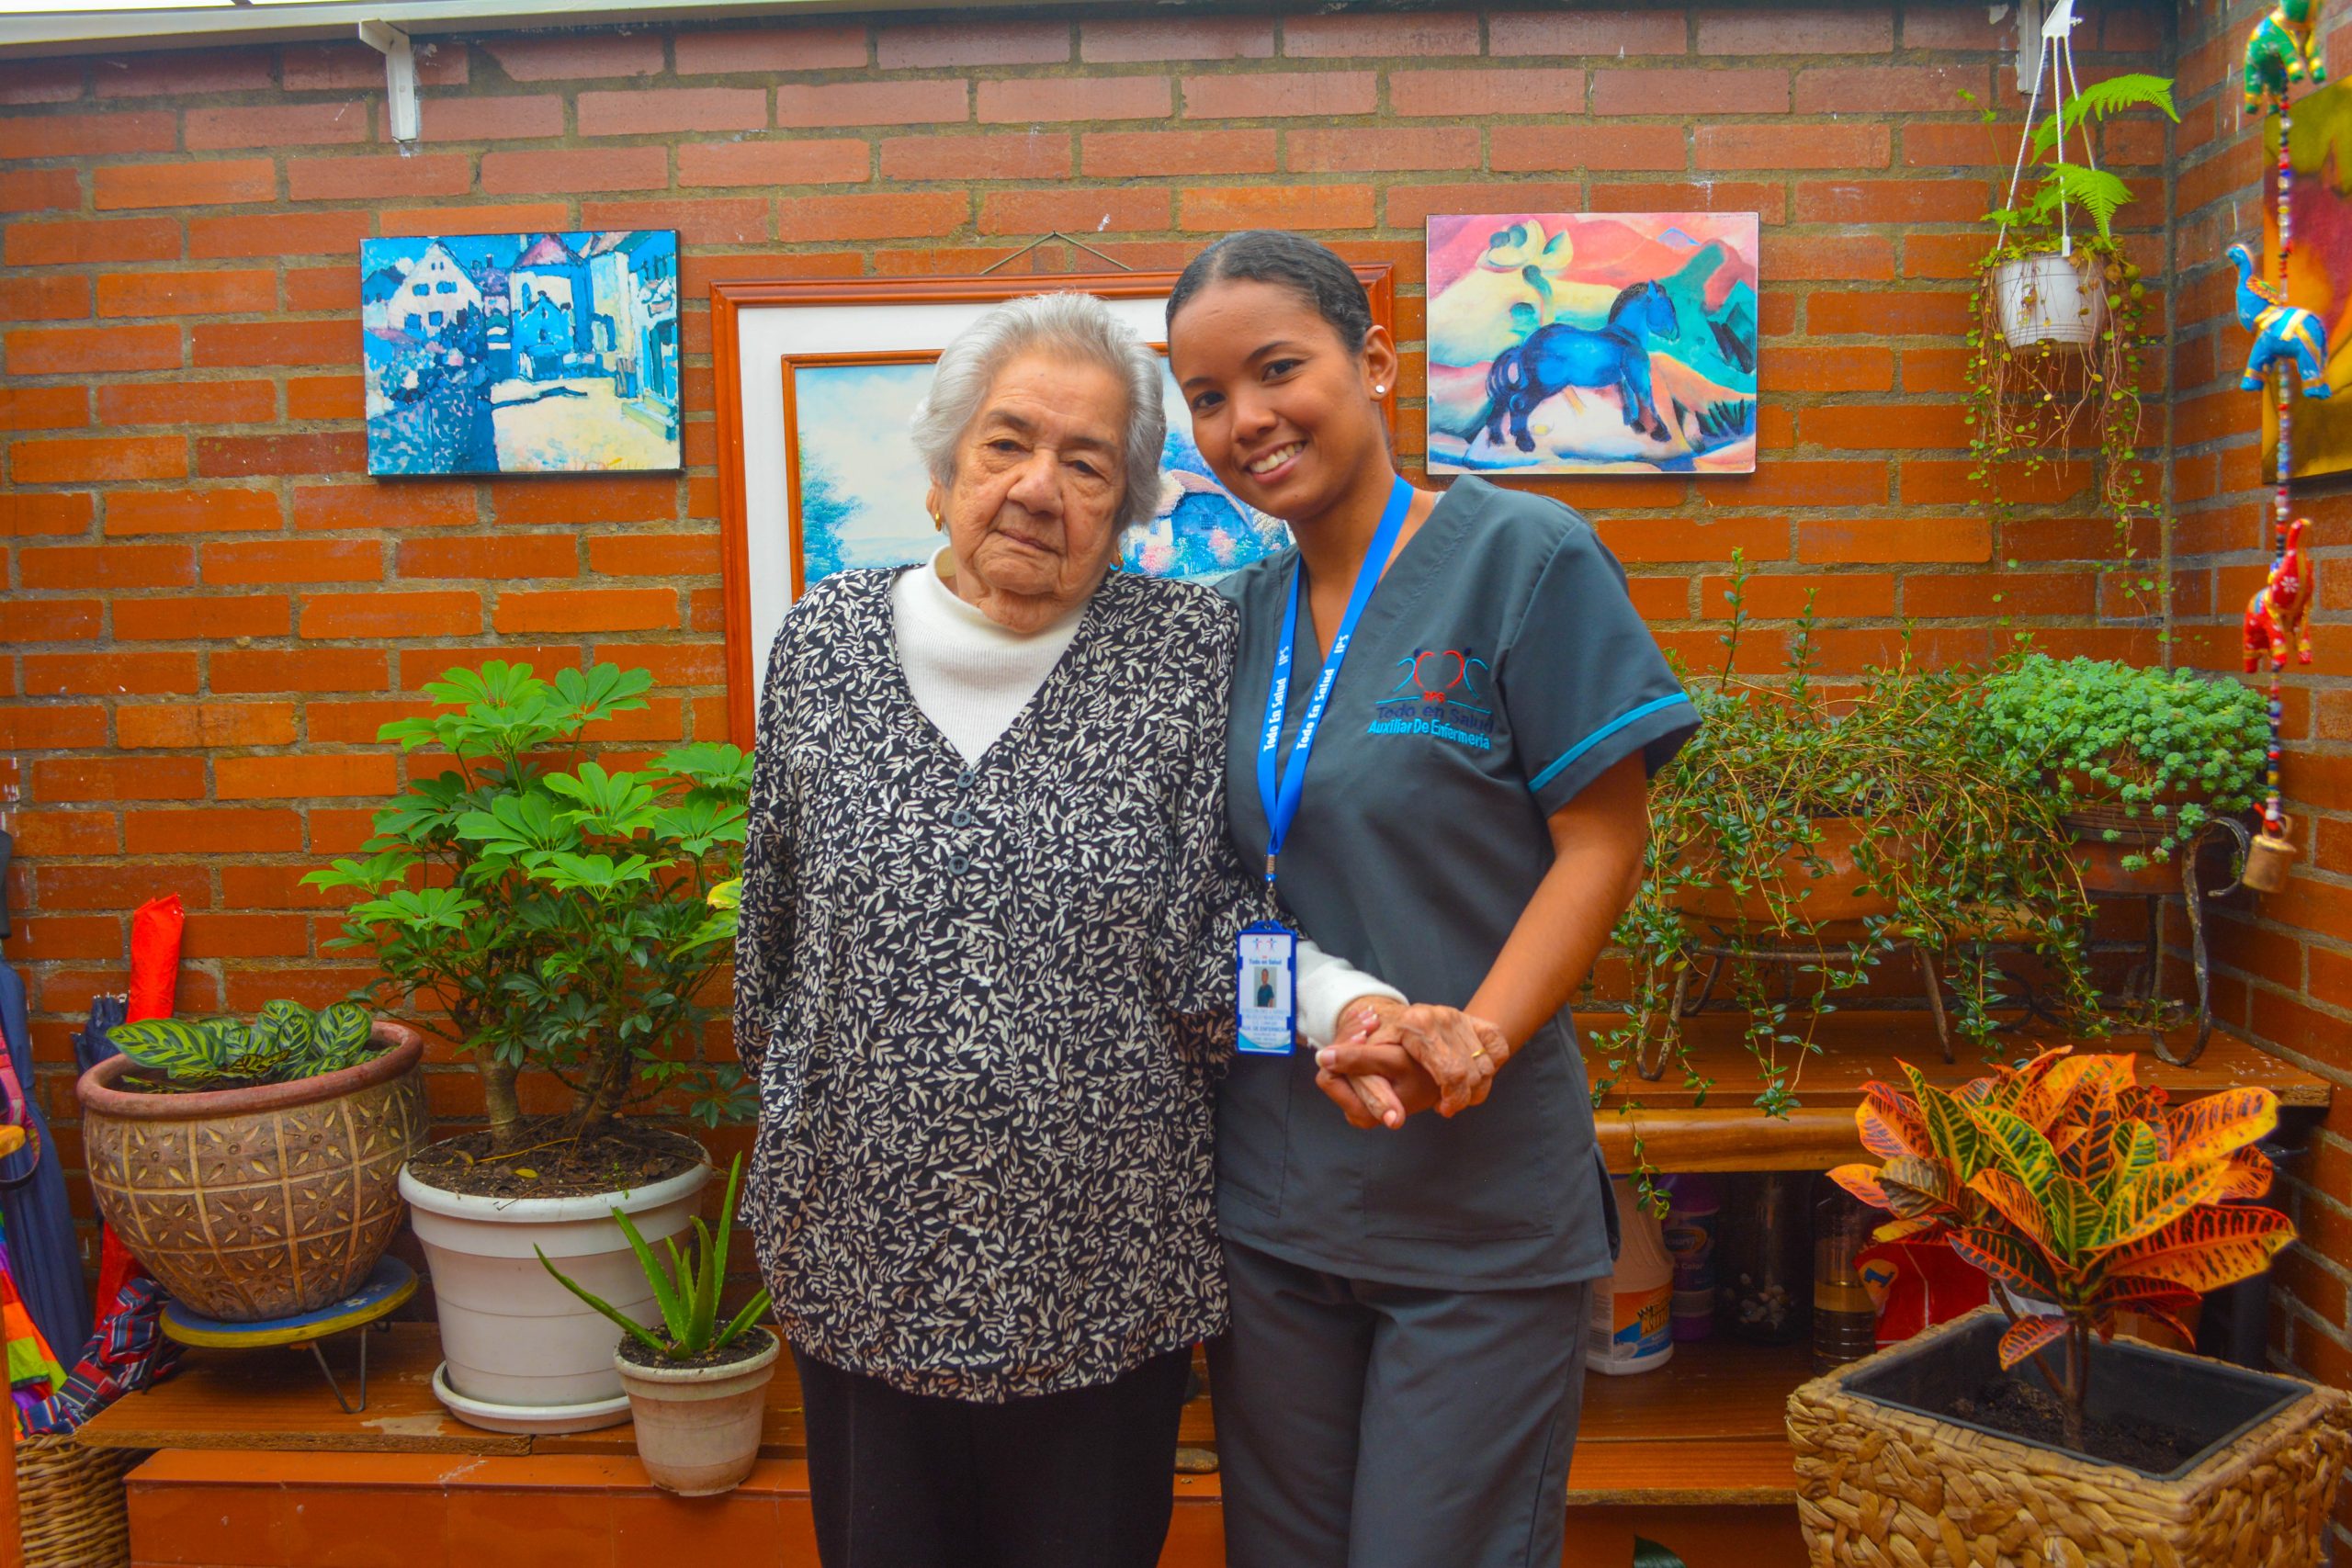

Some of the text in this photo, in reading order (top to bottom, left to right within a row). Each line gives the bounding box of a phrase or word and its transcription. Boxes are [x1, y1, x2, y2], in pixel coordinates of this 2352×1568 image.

[1263, 646, 1290, 752] Todo En Salud IPS
[1296, 634, 1350, 750] Todo En Salud IPS
[1423, 690, 1446, 703] IPS
[1367, 719, 1413, 734] Auxiliar
[1413, 718, 1430, 734] De
[1376, 704, 1495, 734] Todo en Salud
